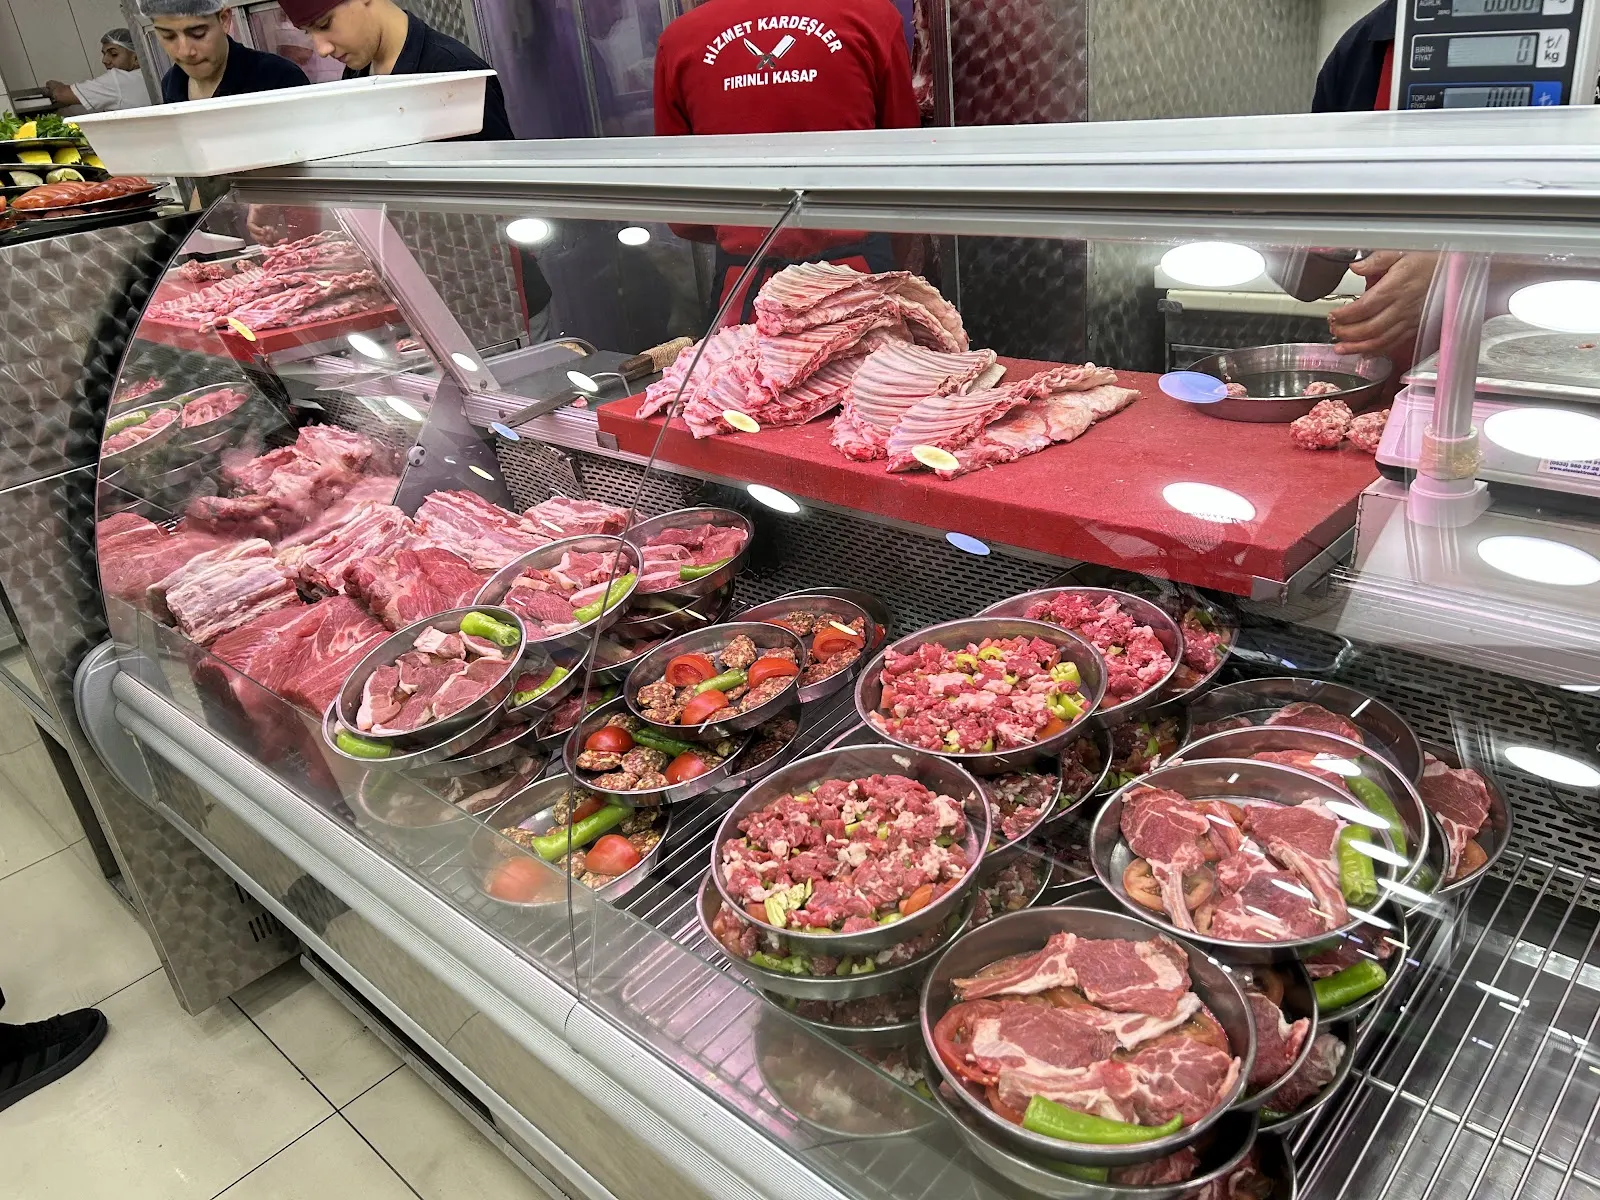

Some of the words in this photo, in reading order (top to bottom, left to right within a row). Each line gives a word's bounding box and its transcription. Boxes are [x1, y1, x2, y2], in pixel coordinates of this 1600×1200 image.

[703, 21, 752, 65] HİZMET
[757, 15, 843, 53] KARDEŞLER
[1516, 37, 1530, 63] 0
[1544, 50, 1560, 63] kg
[723, 72, 768, 91] FIRINLI
[773, 69, 817, 84] KASAP
[1411, 94, 1436, 102] TOPLAM
